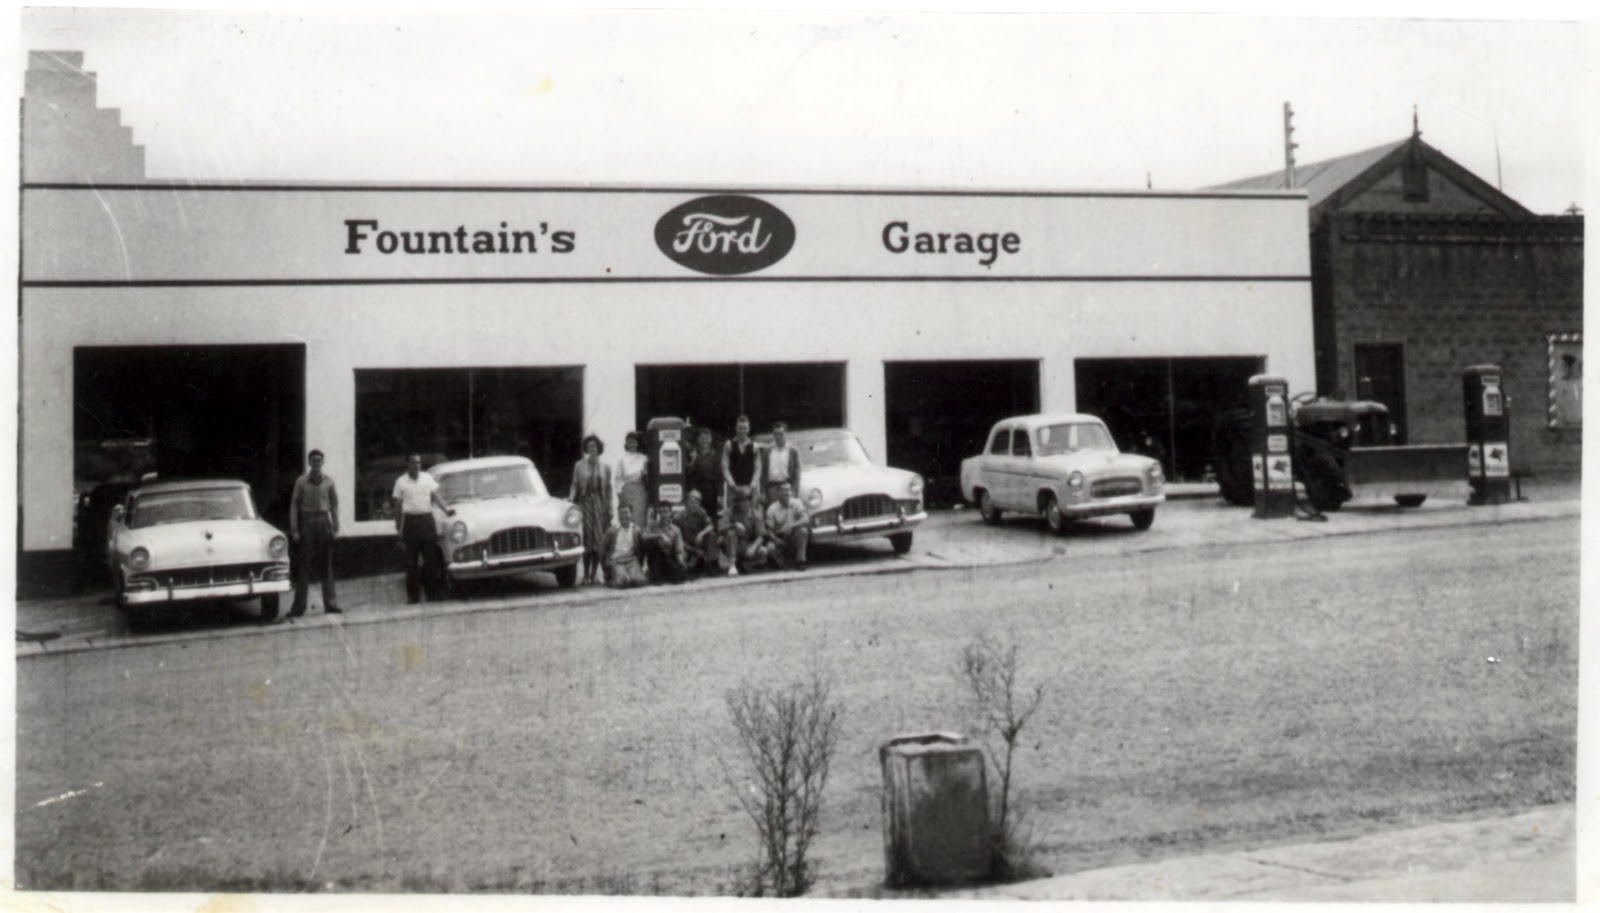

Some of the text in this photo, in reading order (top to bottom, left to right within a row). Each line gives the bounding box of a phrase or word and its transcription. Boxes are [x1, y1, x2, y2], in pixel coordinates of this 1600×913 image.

[345, 212, 1020, 264] Fountain's Ford Garage
